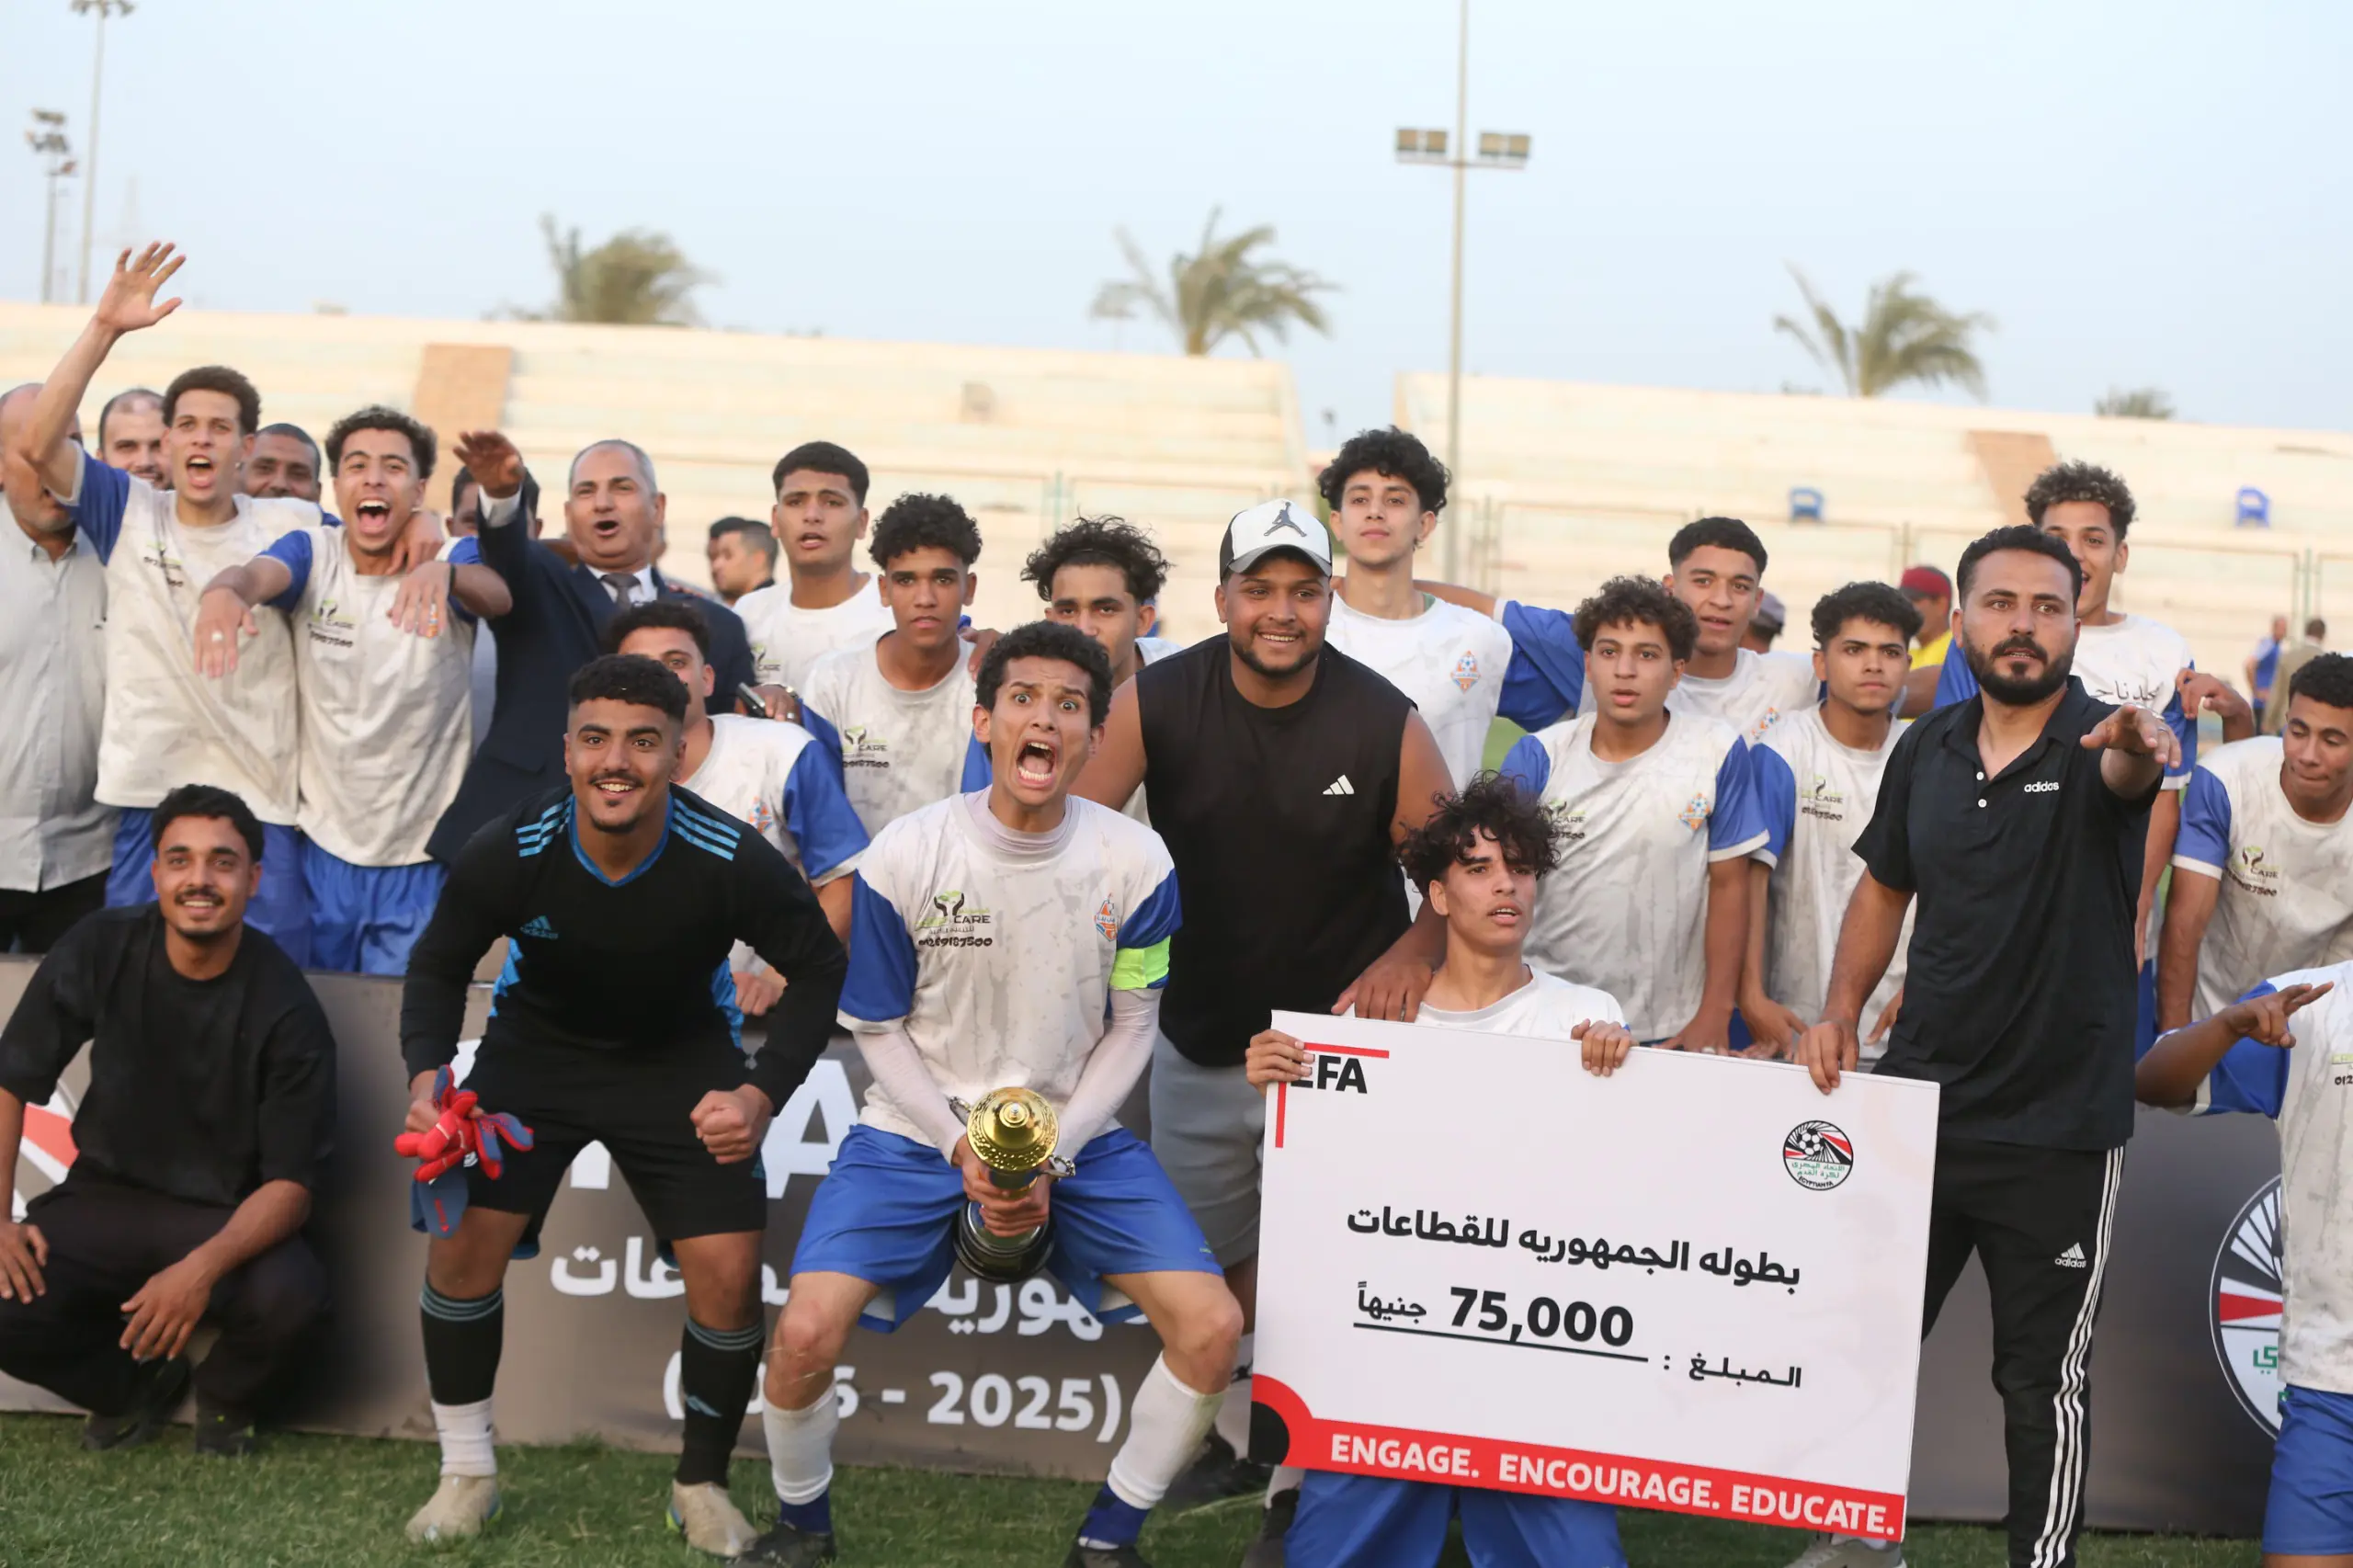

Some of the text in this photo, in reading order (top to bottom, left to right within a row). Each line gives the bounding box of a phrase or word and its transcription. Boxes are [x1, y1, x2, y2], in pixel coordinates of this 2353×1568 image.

[2024, 780, 2060, 793] adidas
[953, 915, 992, 925] CARE
[1347, 1205, 1801, 1295] بطوله الجمهوريه للقطاعات
[2054, 1257, 2087, 1268] adidas
[1449, 1286, 1634, 1347] 75,000
[1688, 1352, 1802, 1389] المبلغ
[1330, 1433, 1895, 1536] ENGAGE. ENCOURAGE. EDUCATE.
